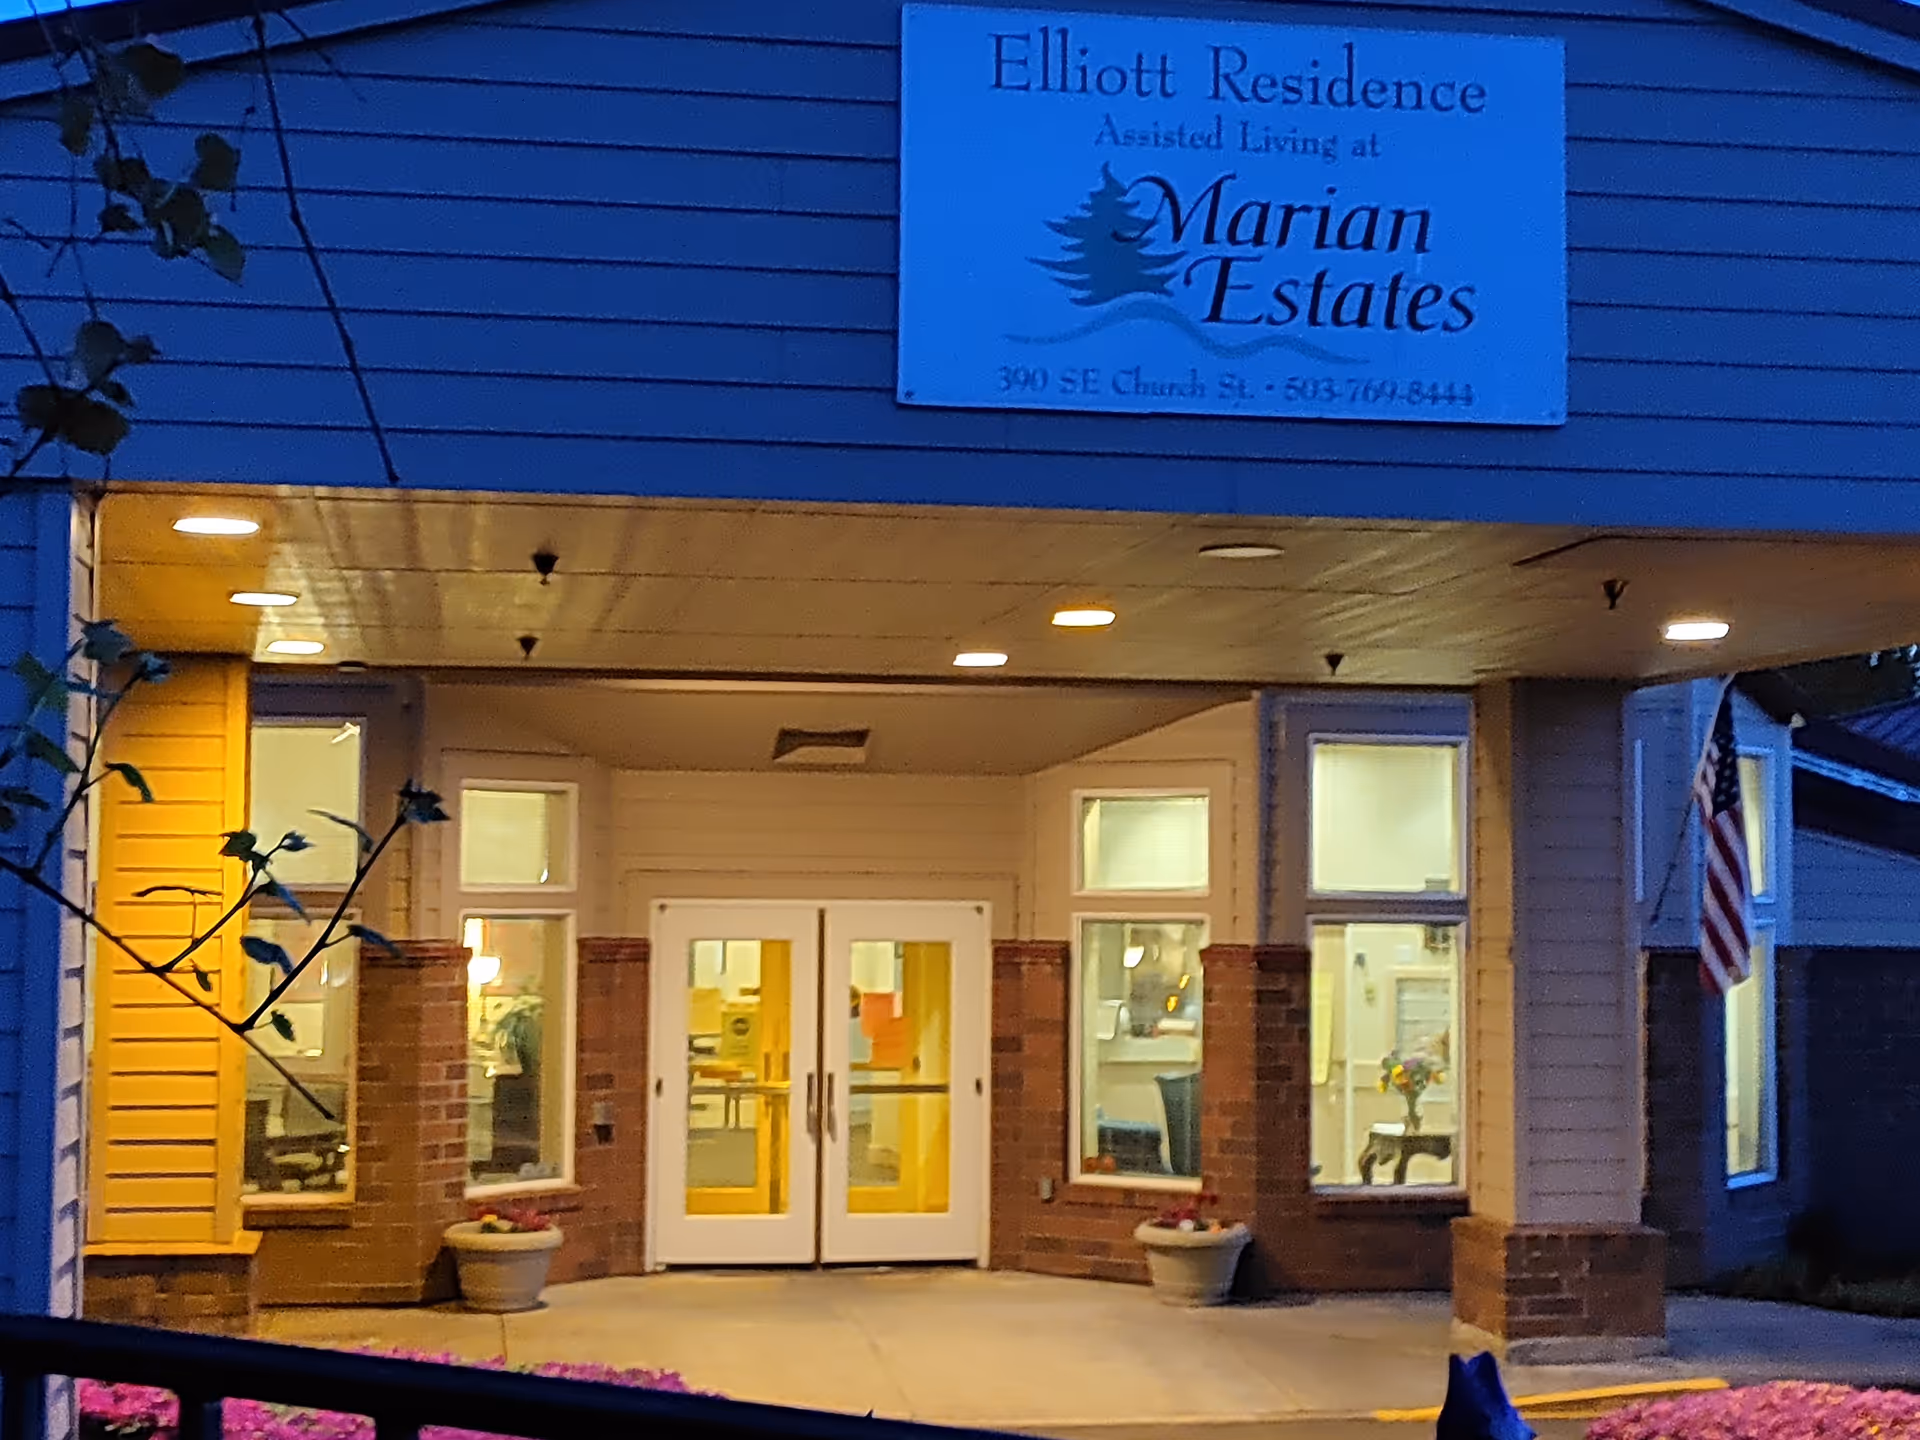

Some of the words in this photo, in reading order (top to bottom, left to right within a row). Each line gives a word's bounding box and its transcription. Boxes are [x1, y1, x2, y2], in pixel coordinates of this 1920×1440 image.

[987, 26, 1176, 99] Elliott
[1206, 42, 1488, 114] Residence
[1094, 112, 1223, 150] Assisted
[1239, 119, 1338, 161] Living
[1351, 131, 1382, 158] at
[1111, 172, 1431, 254] Marian
[1183, 255, 1476, 333] Estates
[999, 366, 1049, 392] 390
[1059, 367, 1099, 395] SE
[1112, 365, 1205, 398] Church
